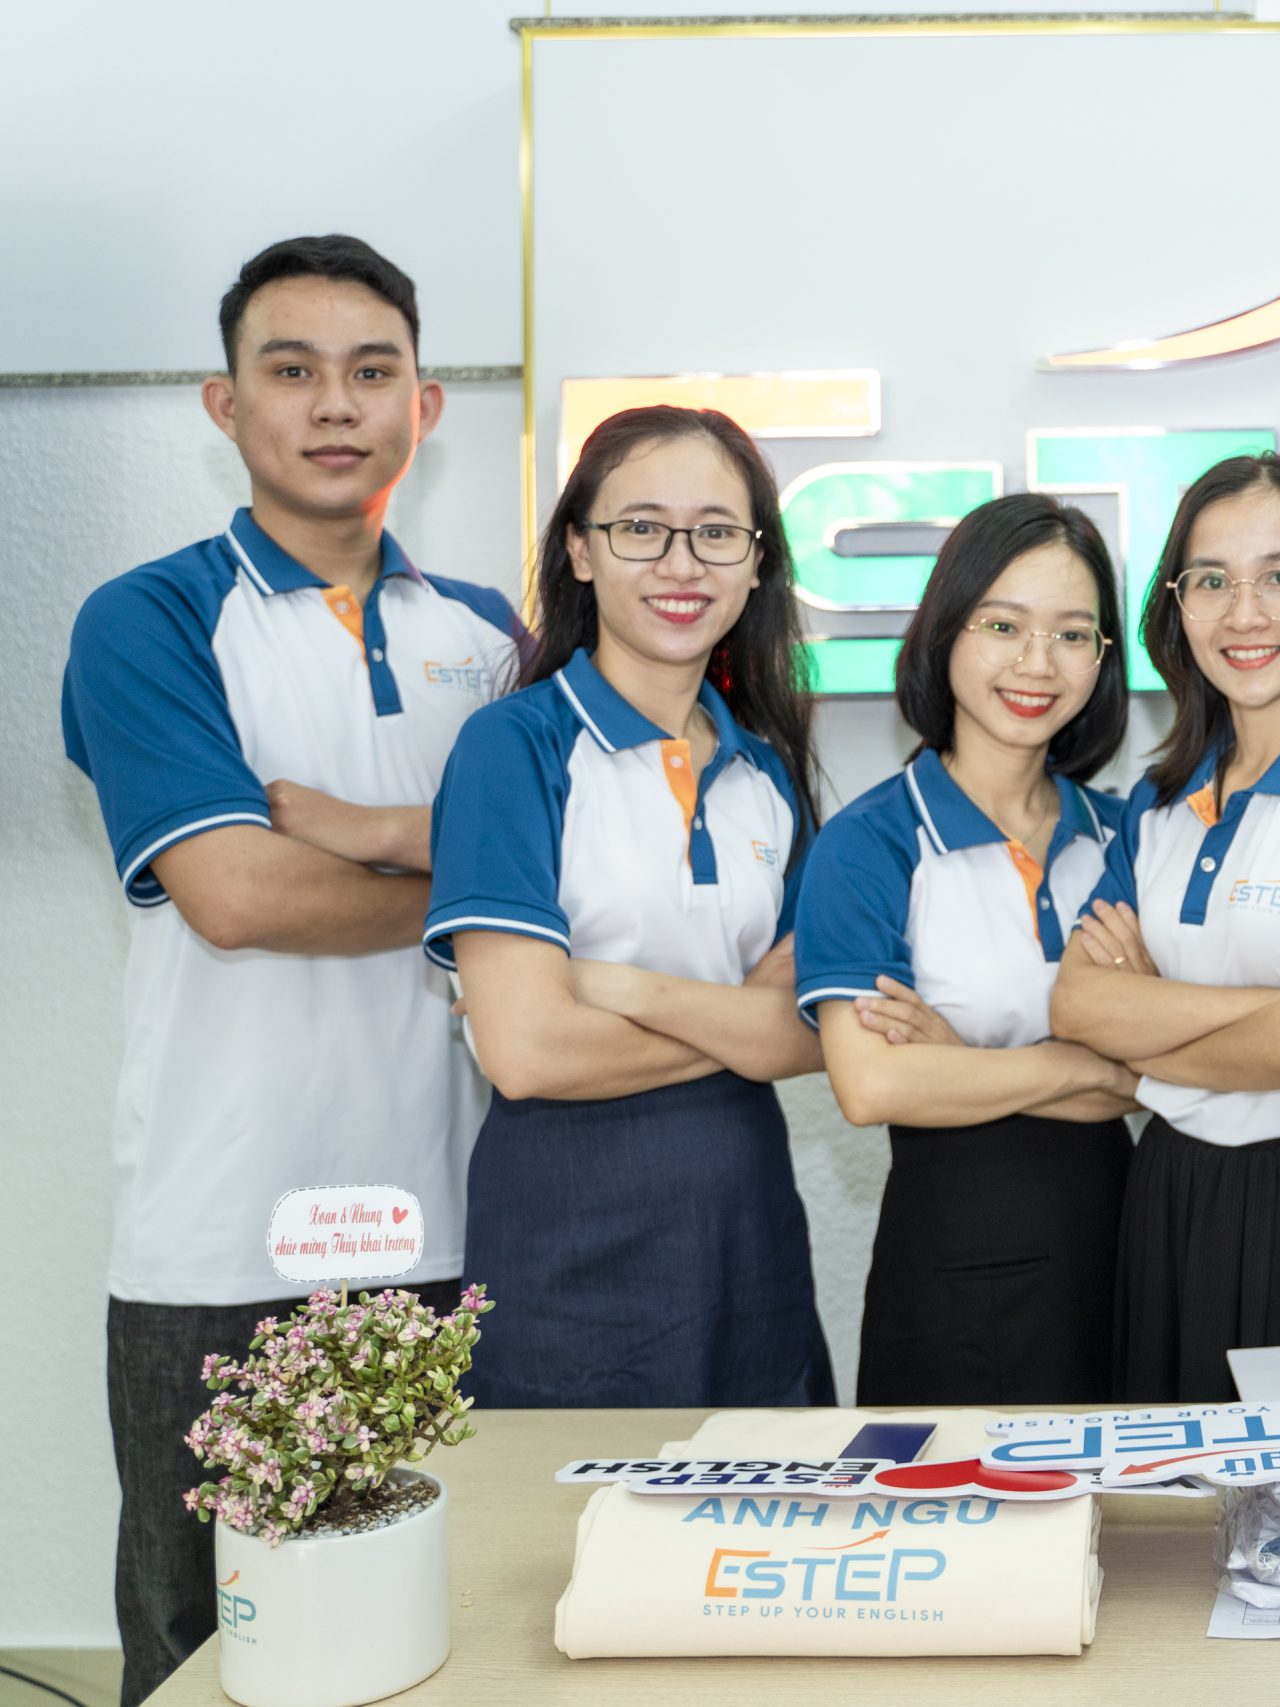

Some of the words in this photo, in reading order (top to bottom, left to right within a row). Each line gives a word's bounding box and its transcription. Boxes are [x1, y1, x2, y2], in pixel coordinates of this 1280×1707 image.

[1177, 1405, 1271, 1418] YOUR
[997, 1414, 1152, 1430] ENGLISH
[572, 1461, 879, 1475] ENGLISH
[645, 1473, 869, 1486] ESTEP
[681, 1497, 830, 1528] ANH
[704, 1547, 947, 1602] ESTEP
[217, 1588, 257, 1629] EP
[703, 1604, 750, 1616] STEP
[759, 1605, 784, 1618] UP
[793, 1606, 846, 1619] YOUR
[856, 1607, 944, 1621] ENGLISH
